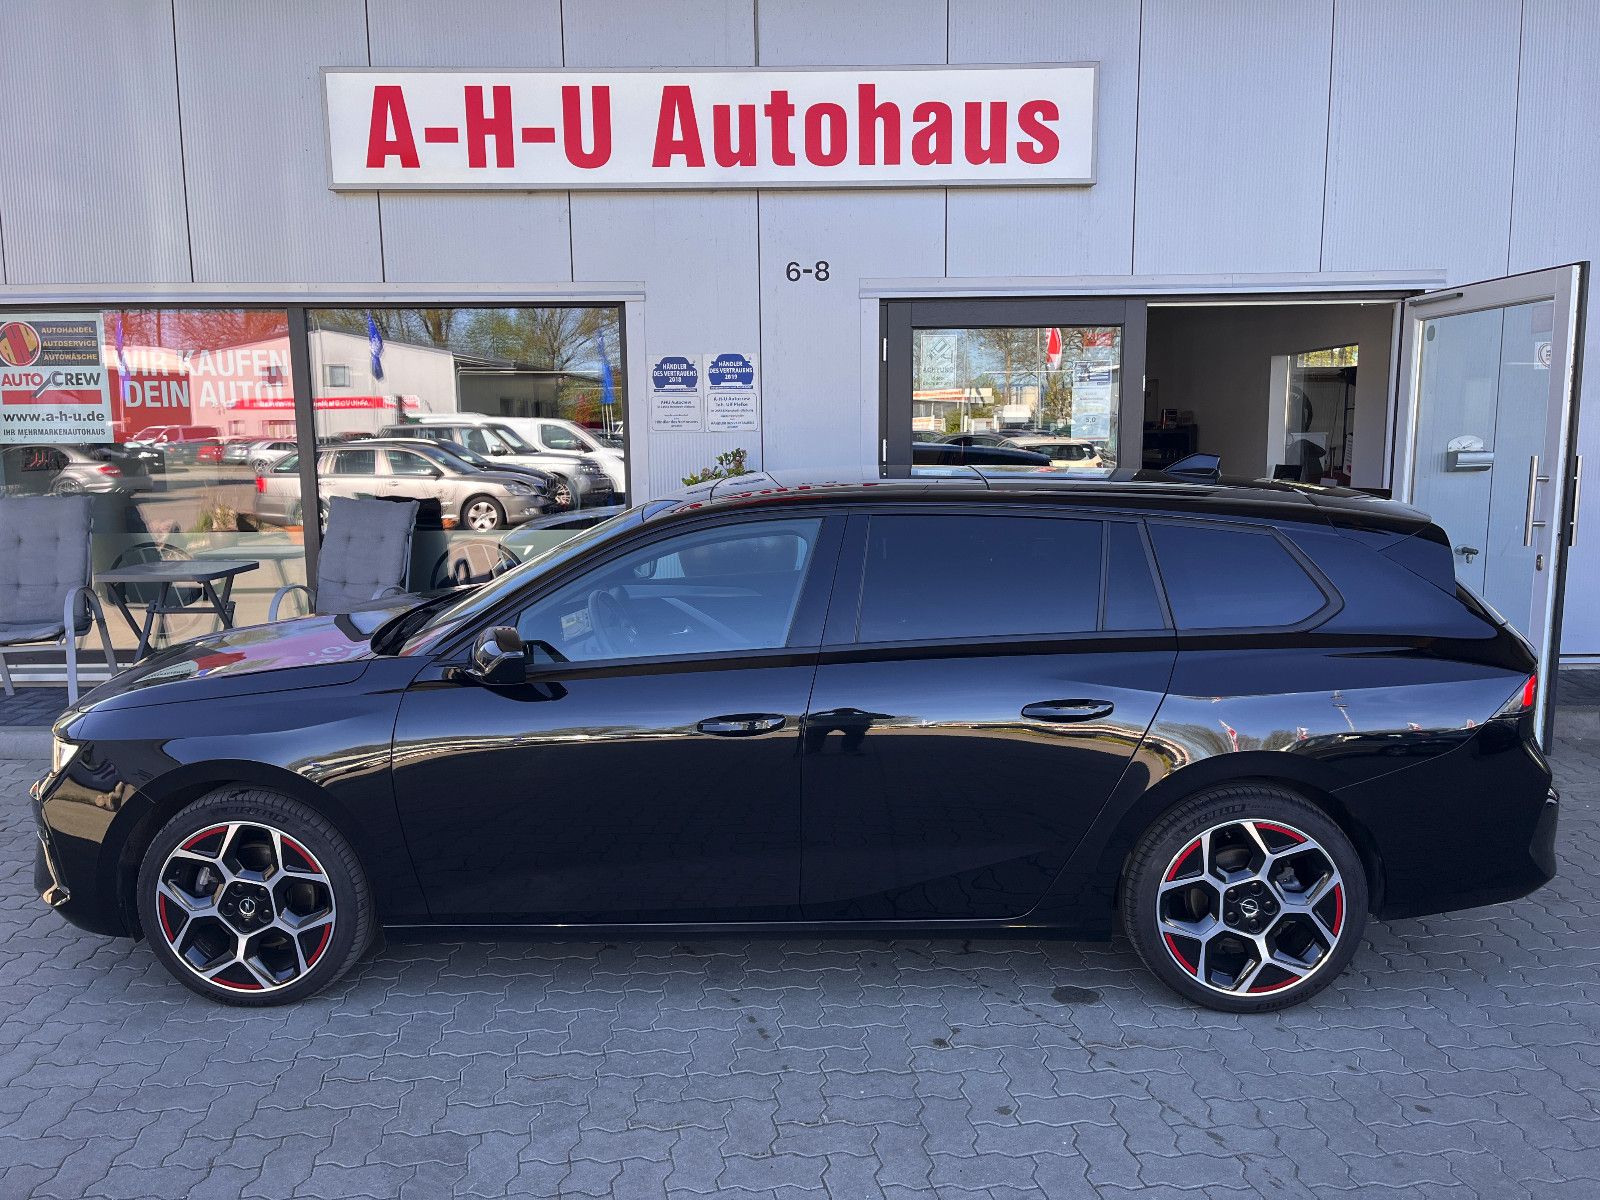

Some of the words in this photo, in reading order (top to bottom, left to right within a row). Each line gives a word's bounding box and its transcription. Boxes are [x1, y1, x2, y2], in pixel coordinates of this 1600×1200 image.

[366, 85, 613, 169] A-H-U
[652, 83, 1061, 167] Autohaus
[786, 261, 830, 281] 6-8
[114, 350, 169, 377] WIR
[177, 349, 289, 377] KAUFEN
[125, 380, 190, 408] DEIN
[3, 410, 105, 422] www.a-h-u.de
[17, 428, 106, 436] MEHRMARKENAUTOHAUS
